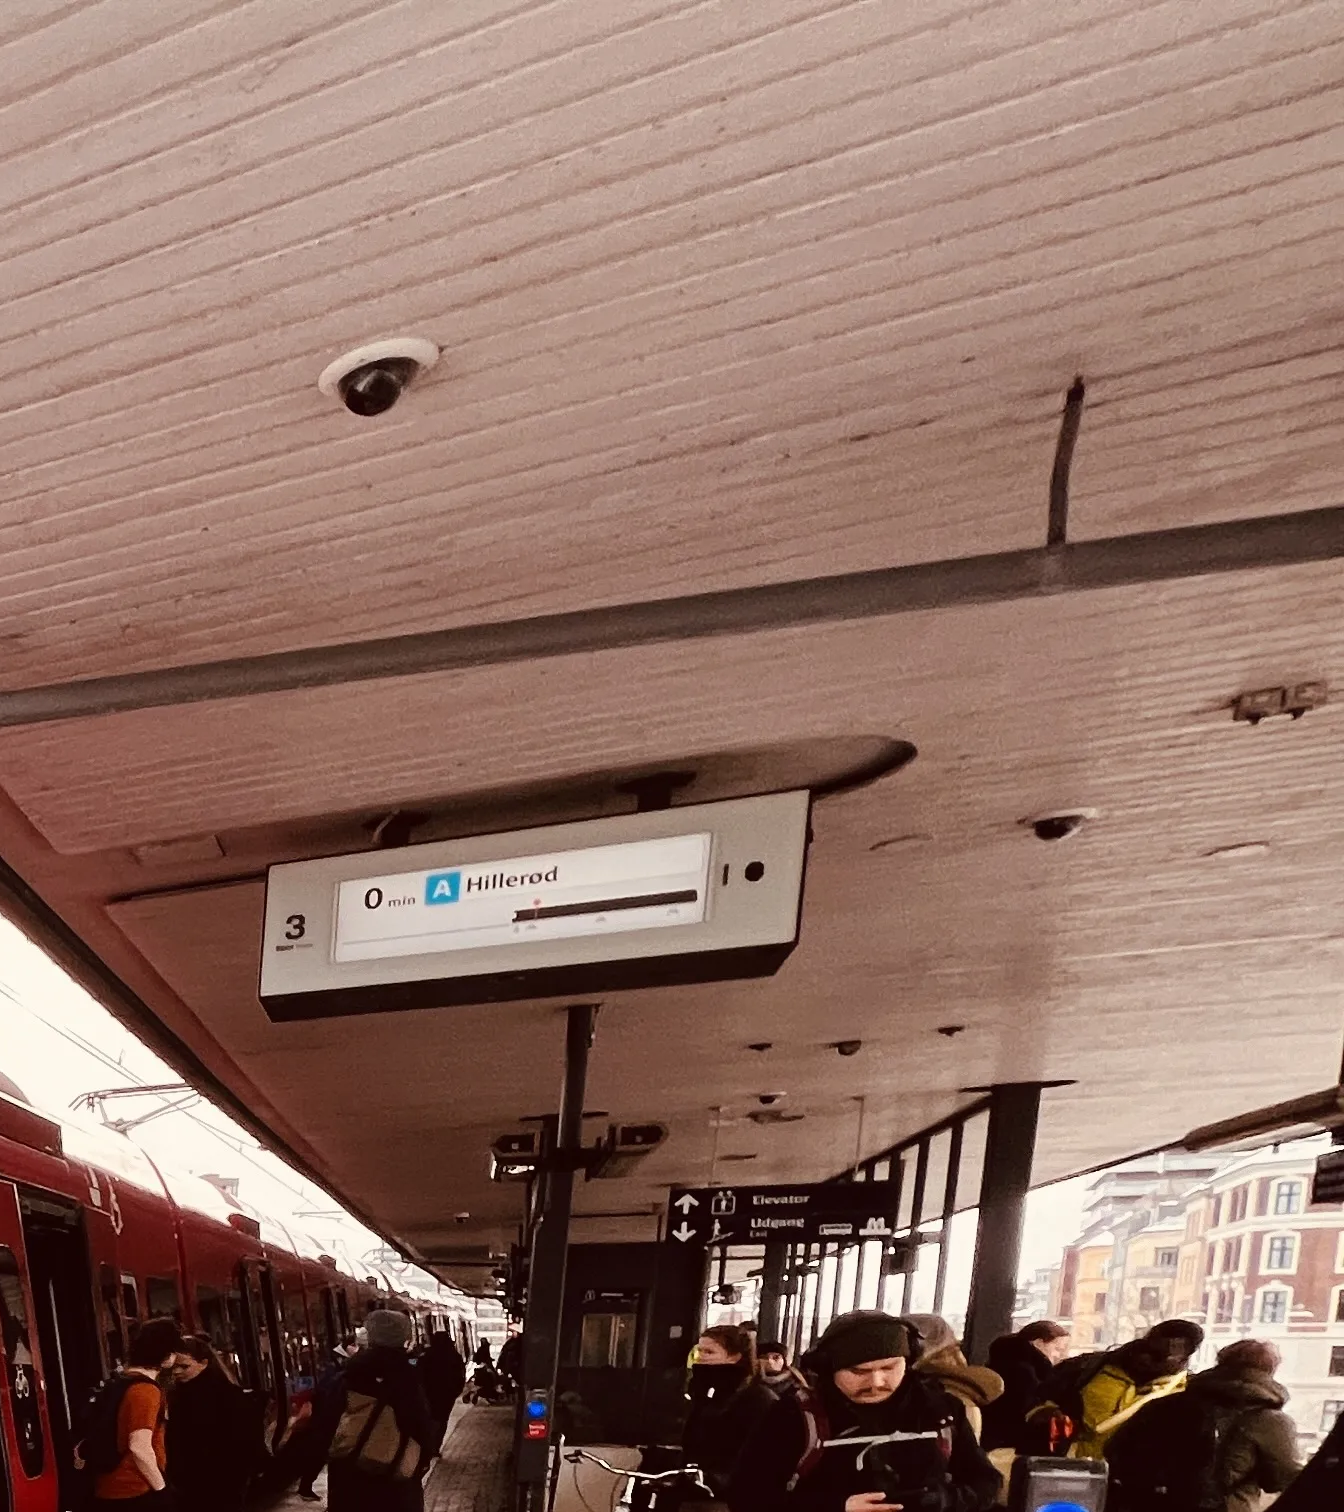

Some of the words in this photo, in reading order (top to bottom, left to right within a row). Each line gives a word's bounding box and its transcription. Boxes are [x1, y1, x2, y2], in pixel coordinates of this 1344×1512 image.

[364, 887, 384, 910] 0
[387, 896, 416, 908] min
[432, 879, 453, 899] A
[466, 866, 559, 893] Hillerød
[285, 914, 306, 940] 3
